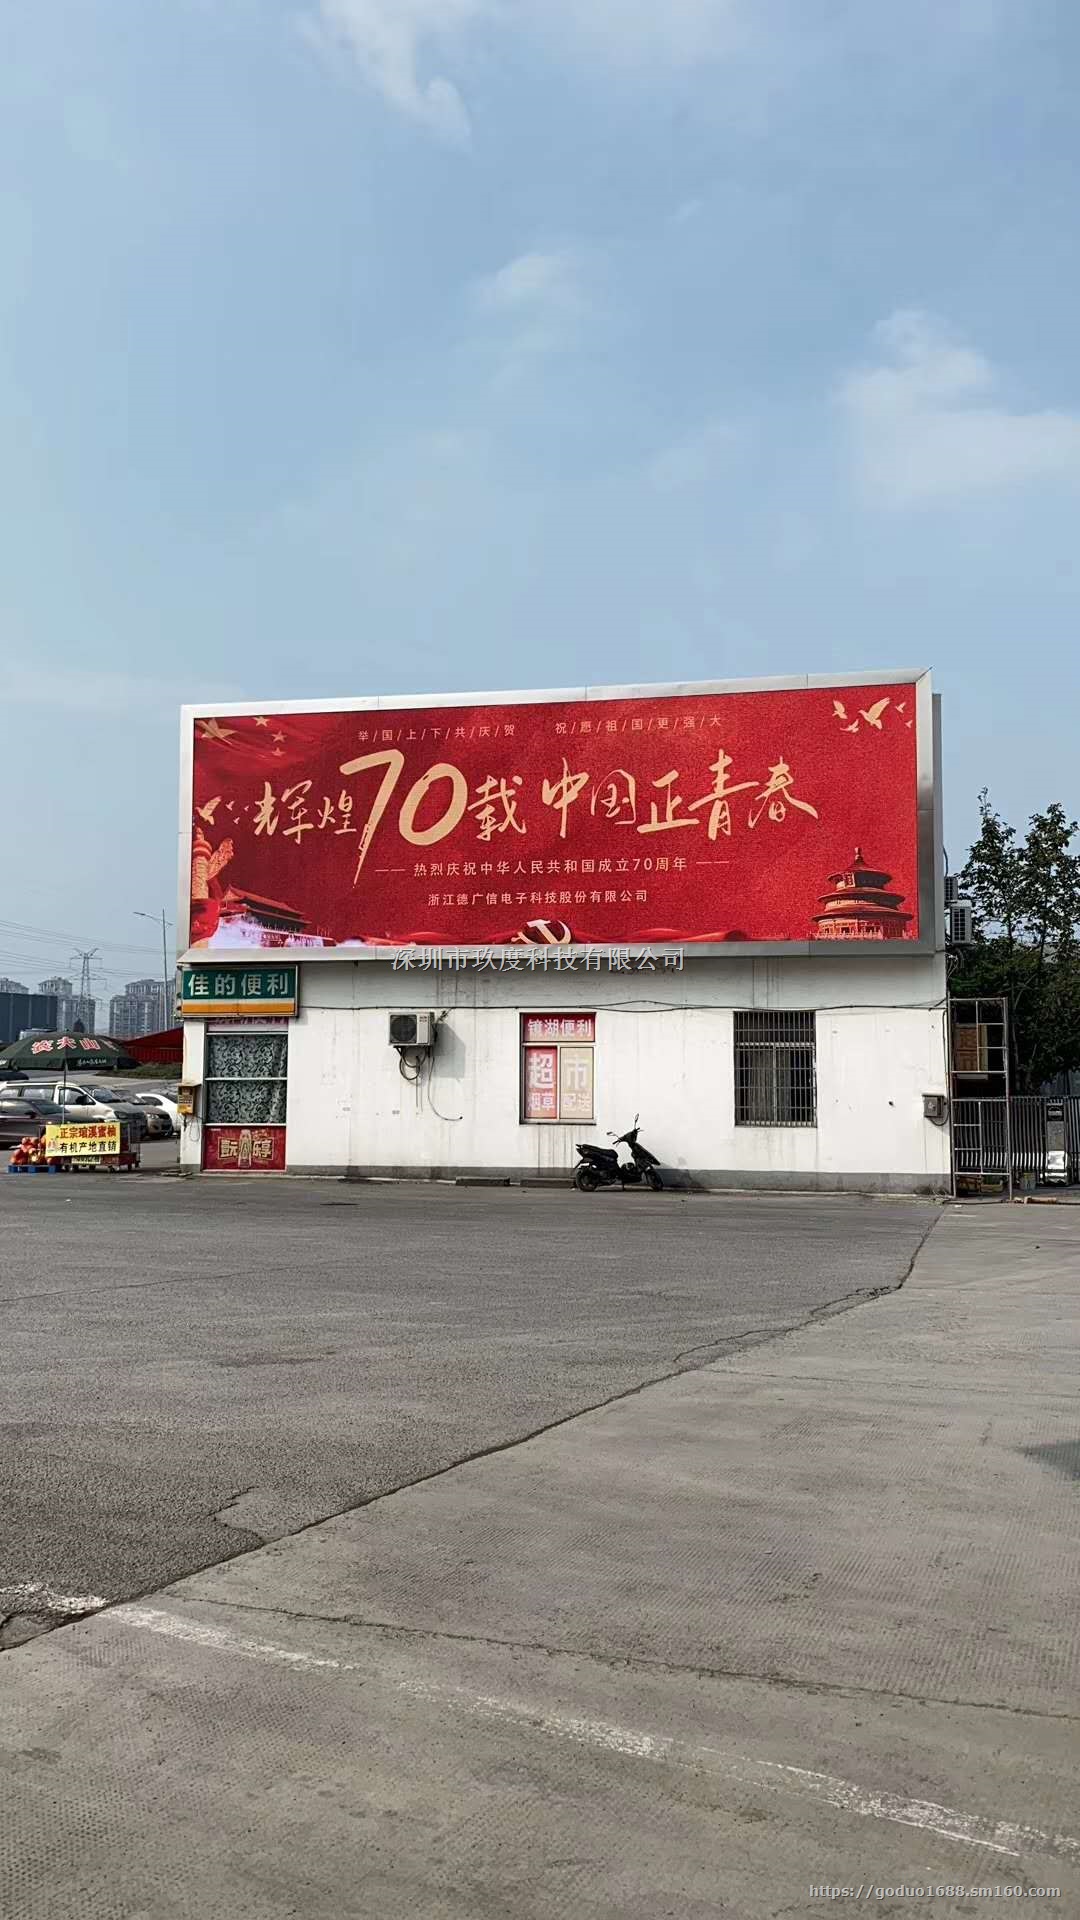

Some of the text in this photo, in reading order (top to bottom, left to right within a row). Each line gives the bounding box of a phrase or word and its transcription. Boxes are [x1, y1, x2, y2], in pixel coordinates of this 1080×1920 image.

[428, 889, 648, 906] 浙江德广信电子科技股份有限公司
[187, 972, 289, 997] 佳的便利
[59, 1140, 117, 1154] 有机产地直销
